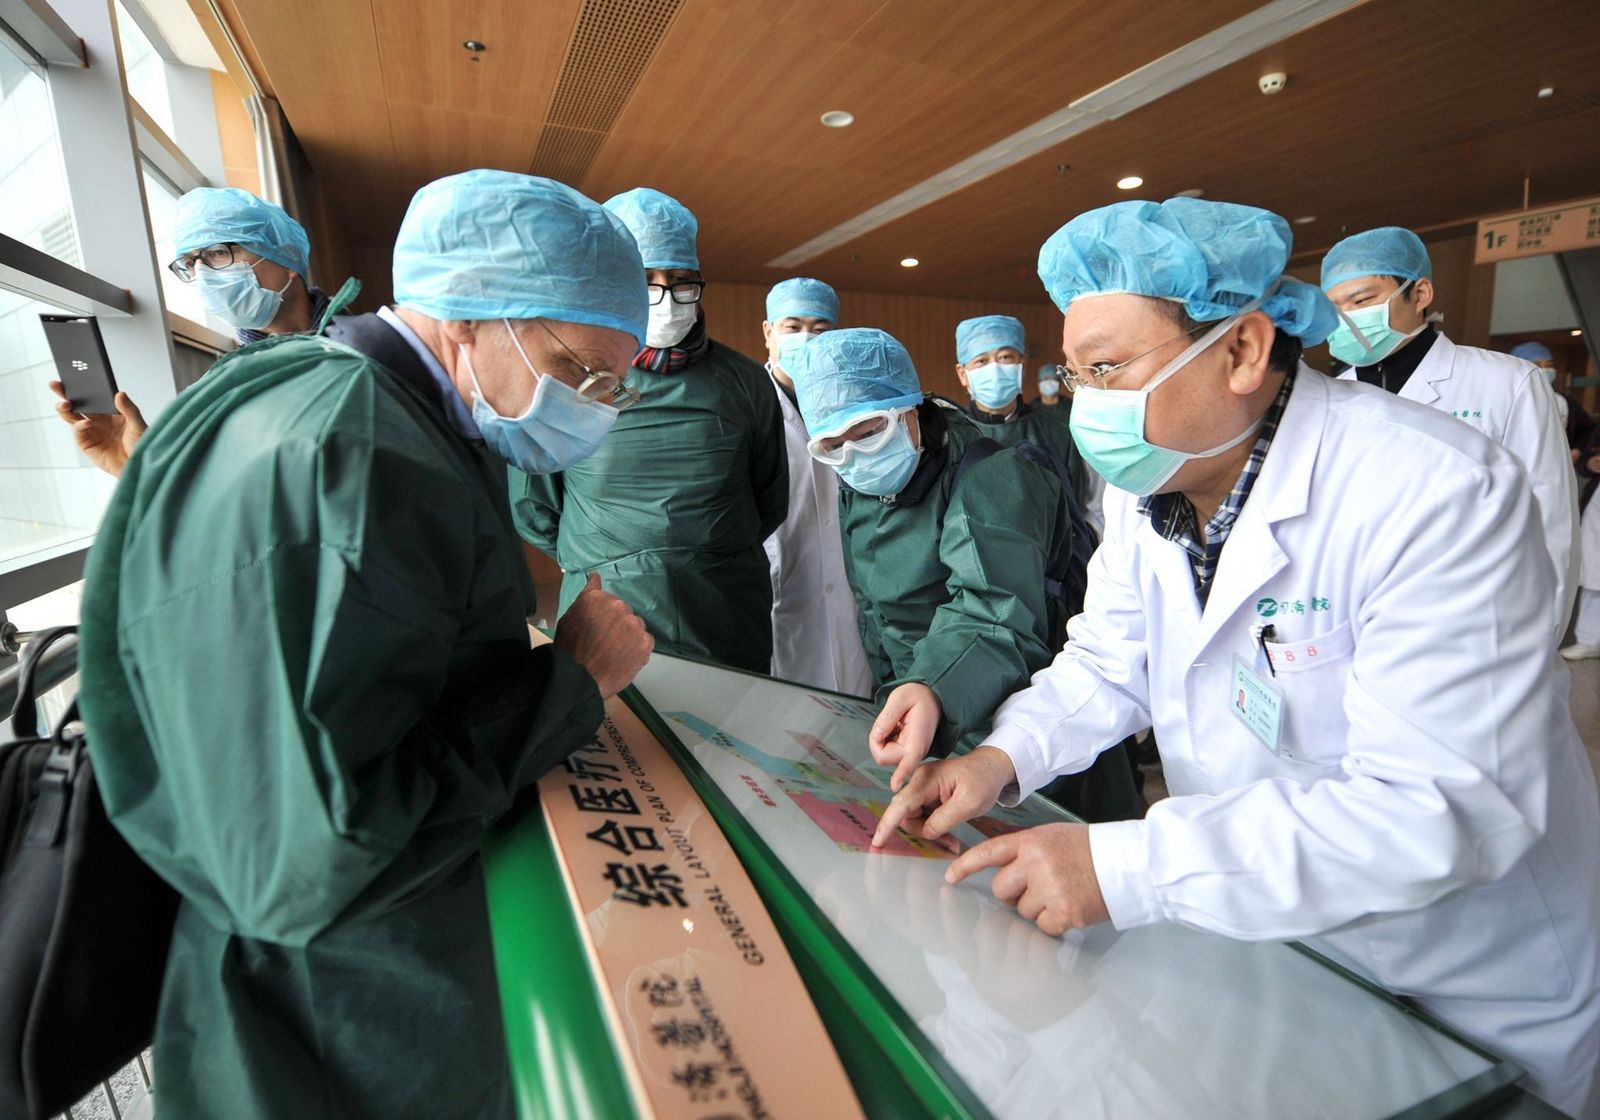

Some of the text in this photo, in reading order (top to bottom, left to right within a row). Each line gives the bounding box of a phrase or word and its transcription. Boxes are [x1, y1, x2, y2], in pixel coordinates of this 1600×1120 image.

[1484, 230, 1508, 250] 1F
[636, 779, 655, 792] OF
[562, 735, 689, 909] 综合医疗
[646, 795, 675, 824] PLAN
[665, 826, 711, 880] LAYOUT
[704, 885, 764, 966] GENERAL
